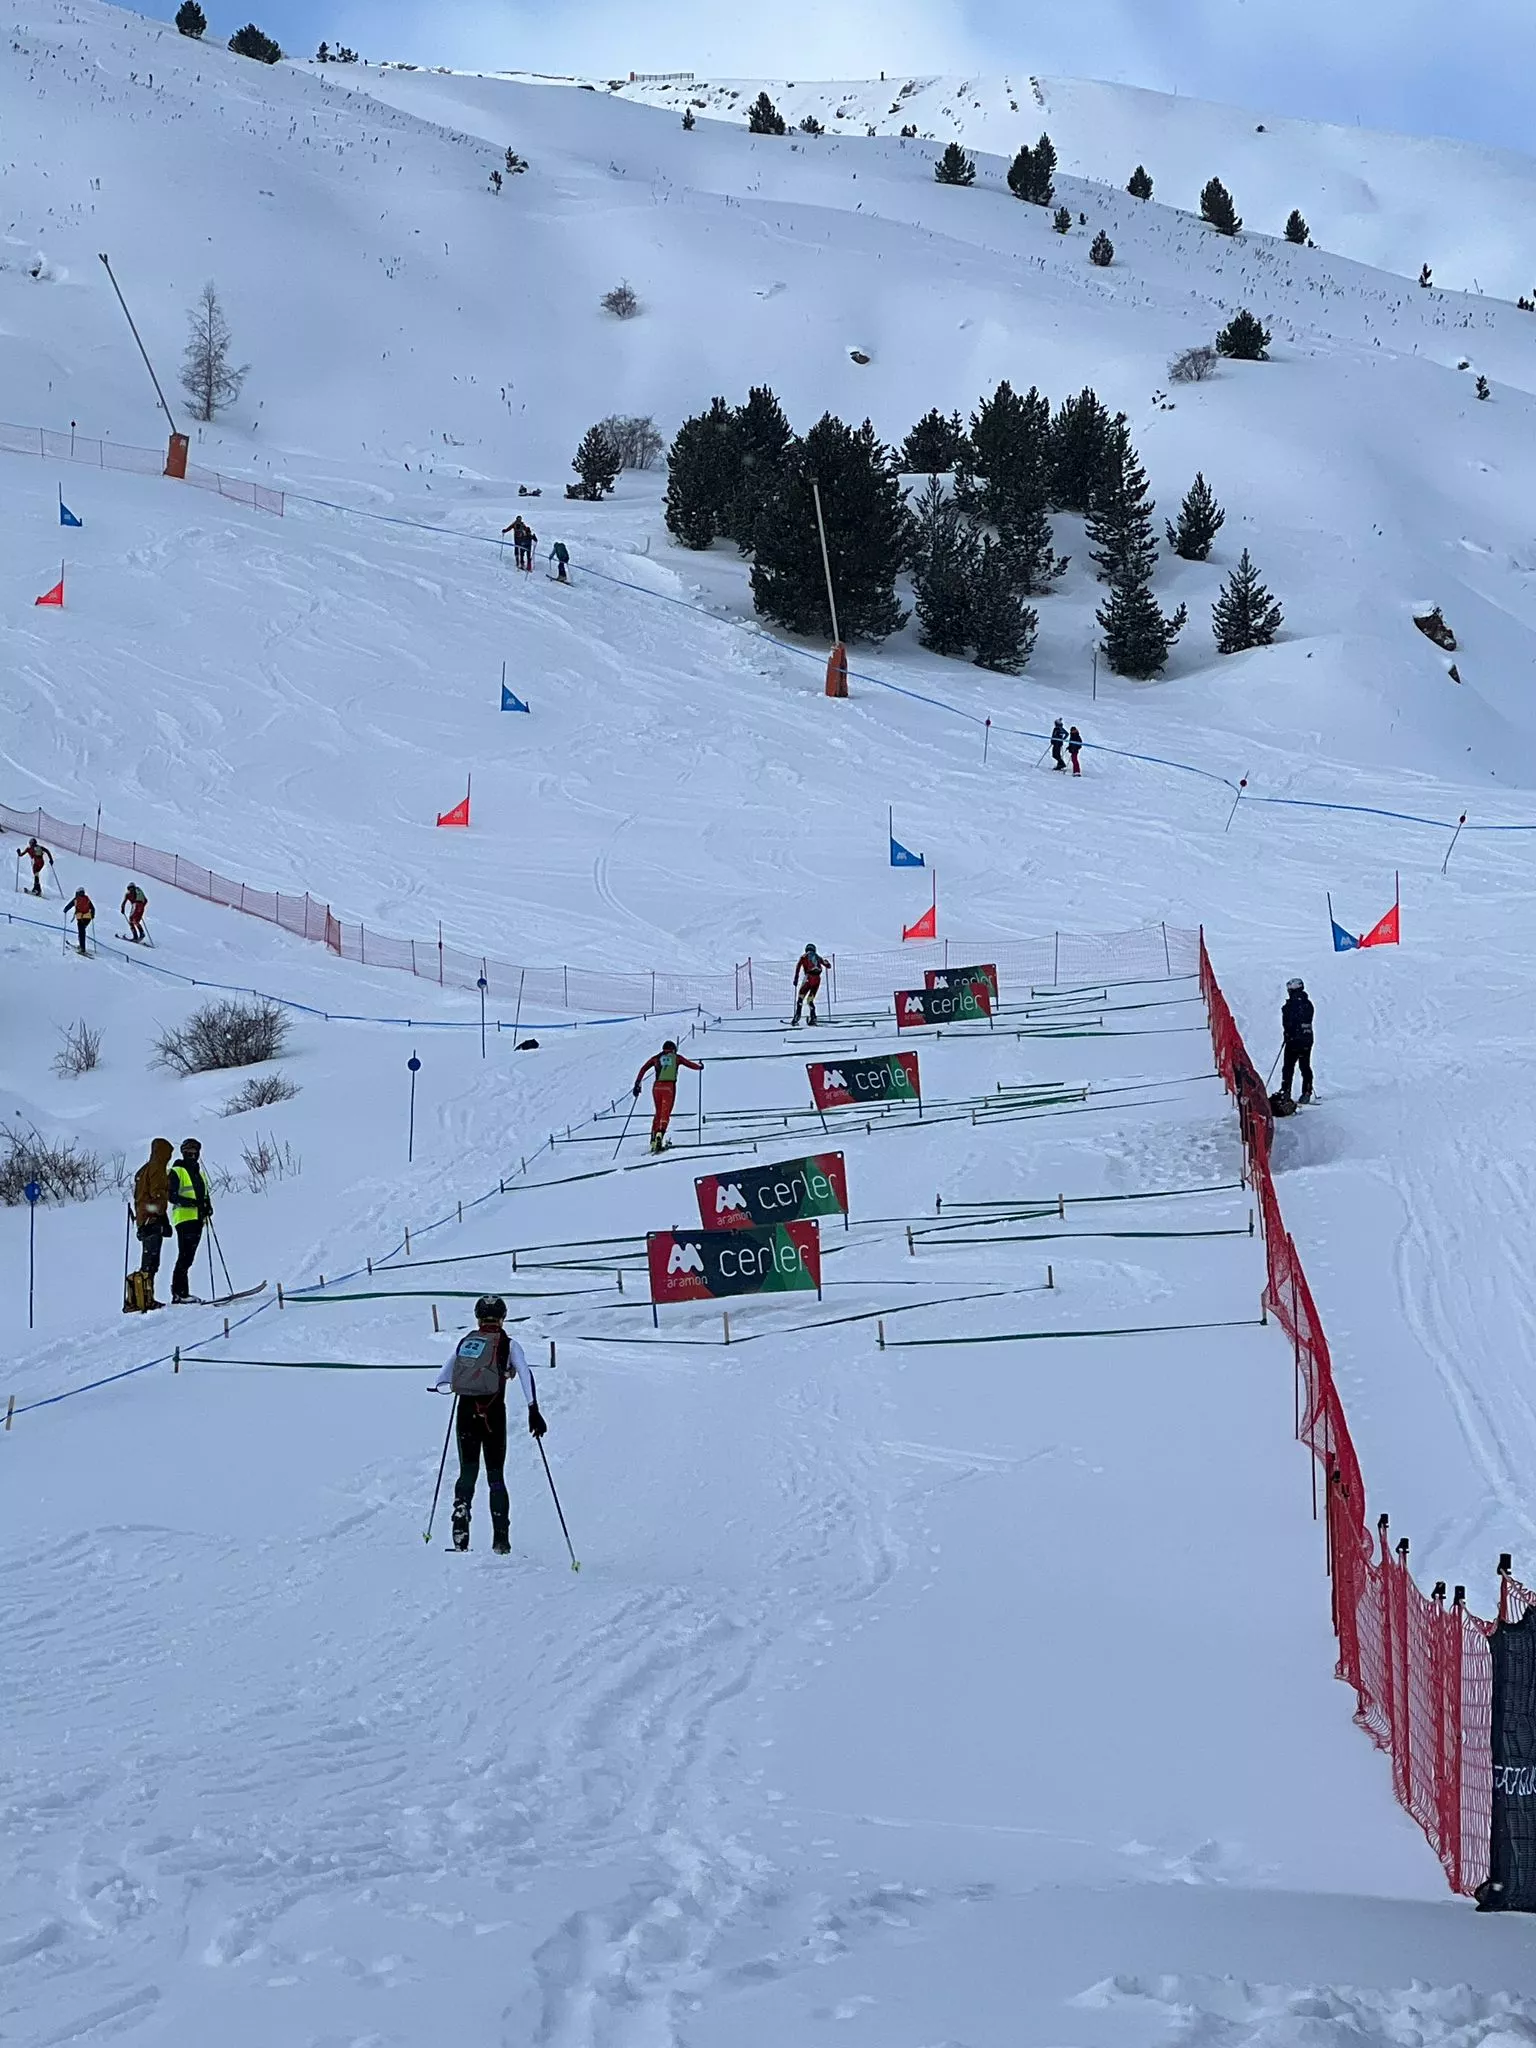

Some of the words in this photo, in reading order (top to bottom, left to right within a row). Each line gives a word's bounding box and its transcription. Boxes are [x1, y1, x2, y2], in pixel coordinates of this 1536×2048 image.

[931, 992, 982, 1015] cerler
[855, 1063, 913, 1091] cerler
[757, 1170, 837, 1210] cerler
[716, 1211, 753, 1226] aramon
[719, 1237, 809, 1278] cerler
[666, 1275, 709, 1289] aramon
